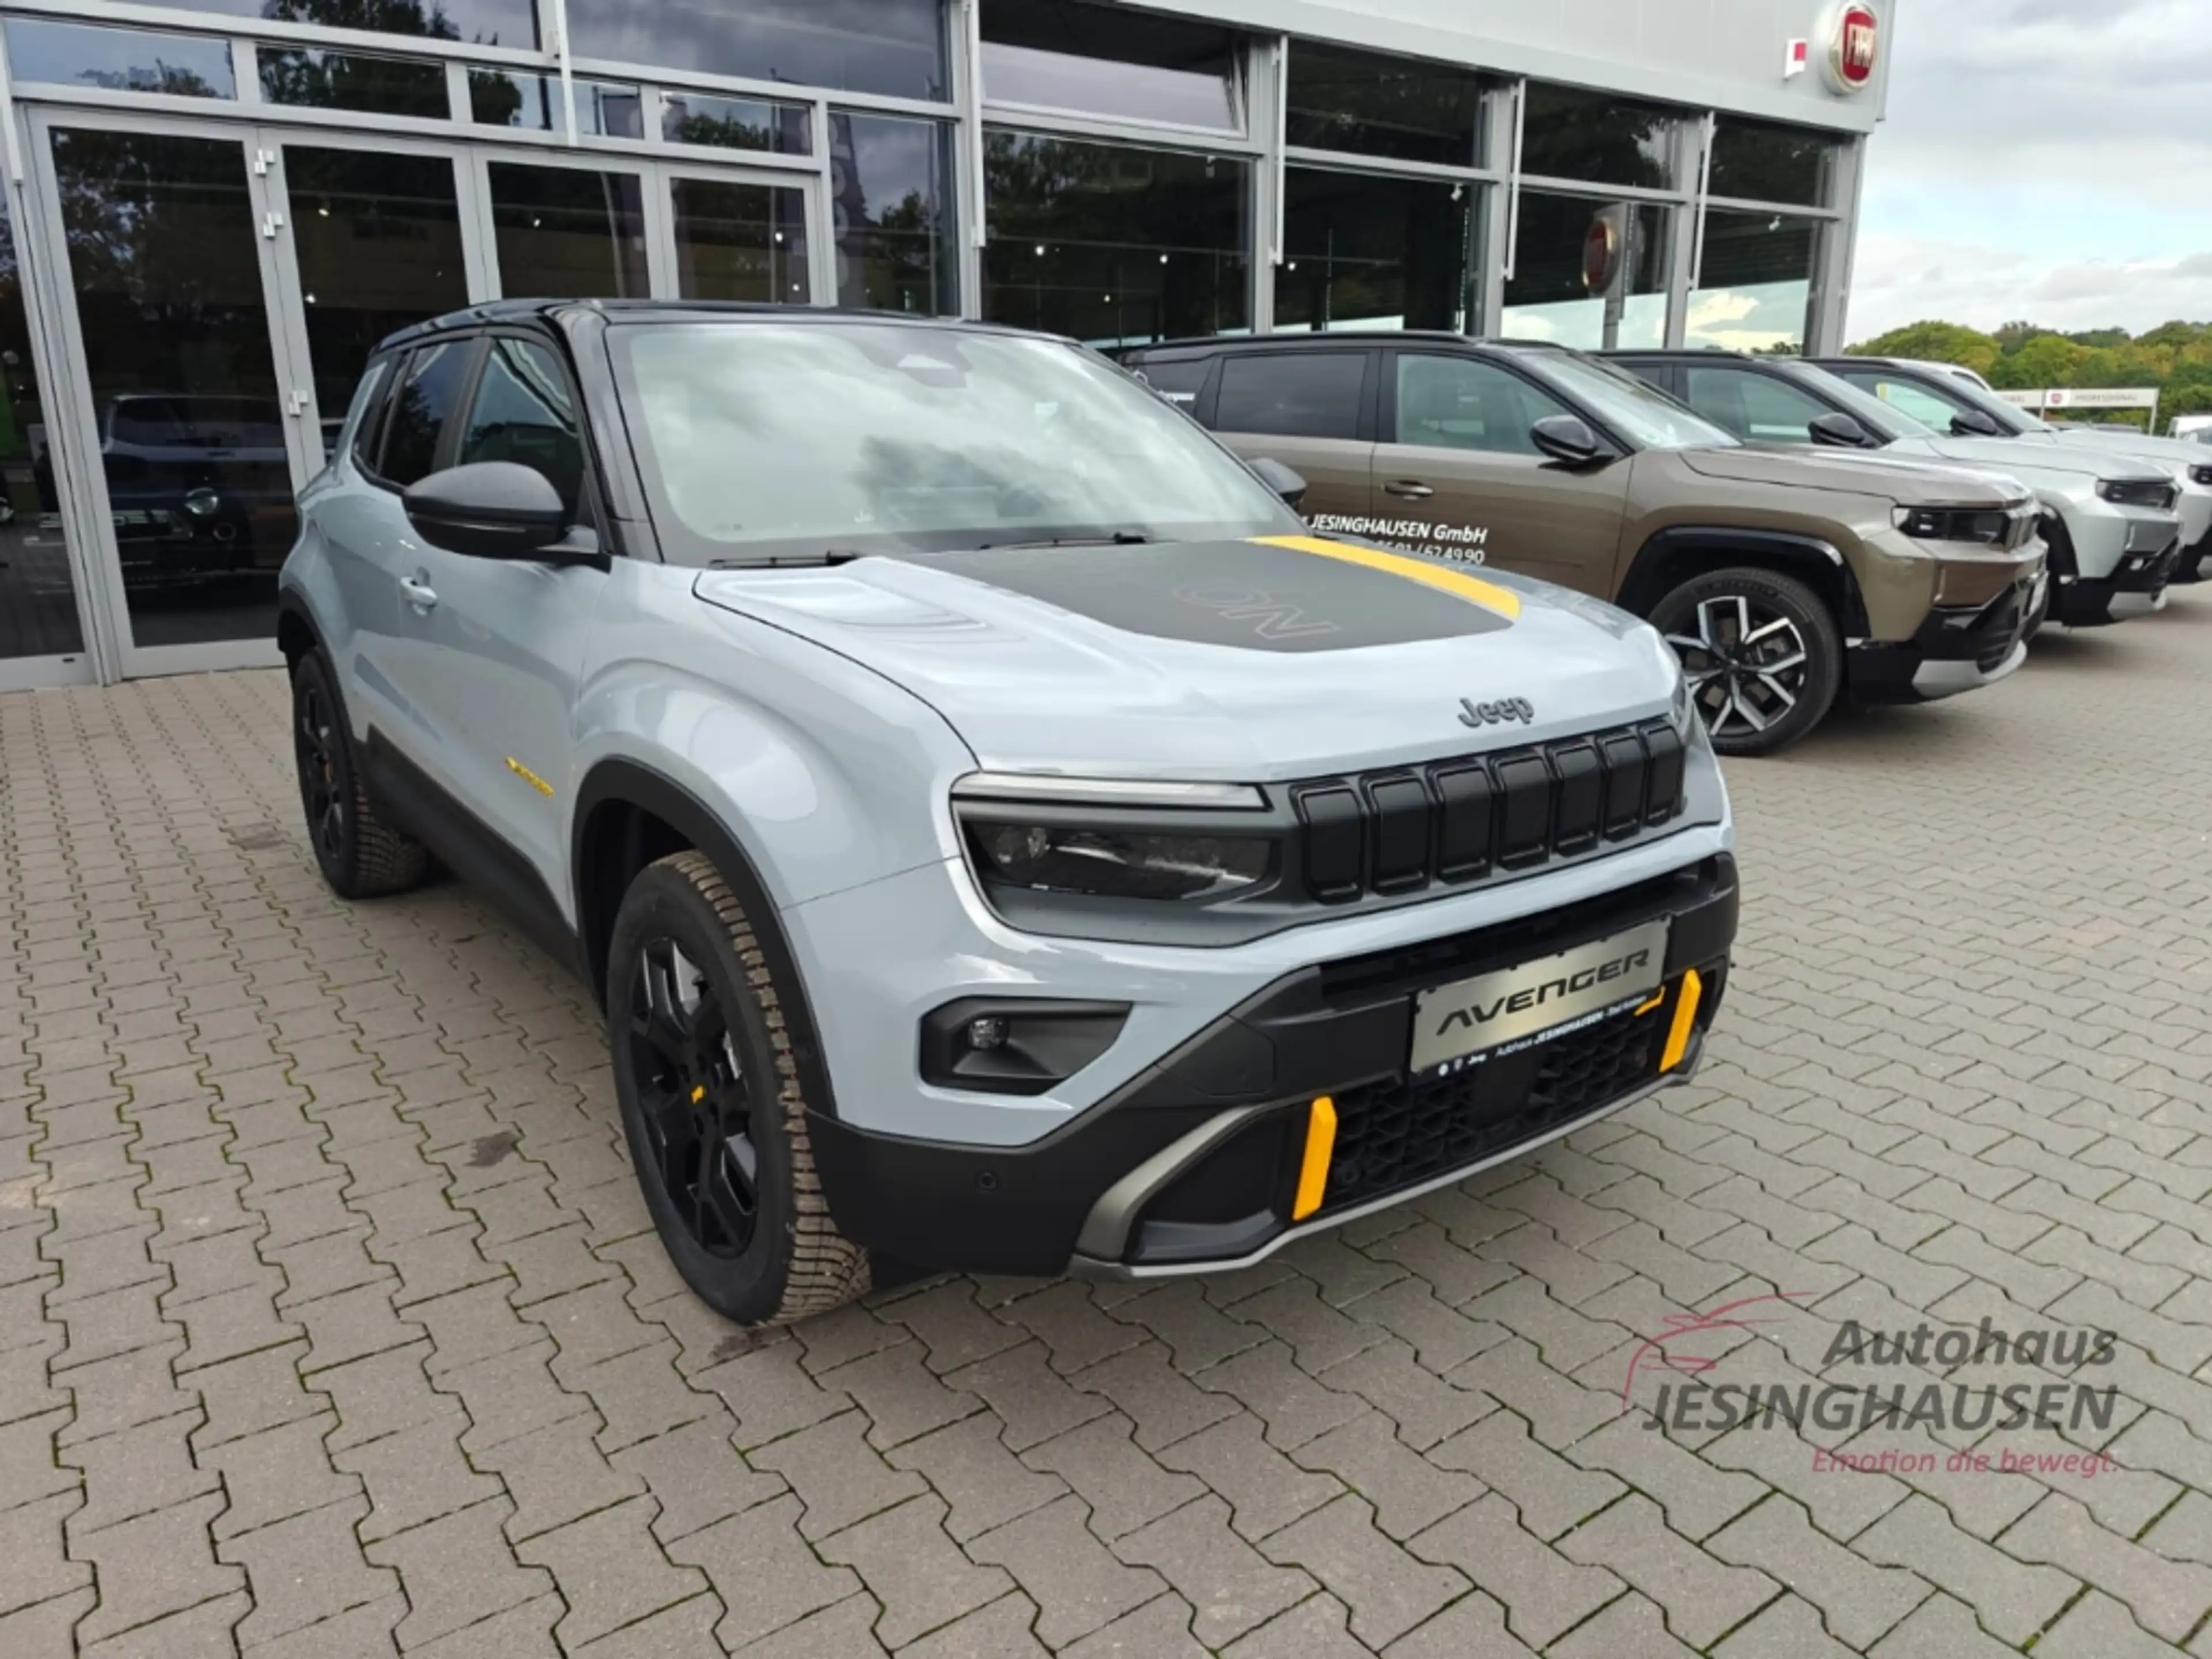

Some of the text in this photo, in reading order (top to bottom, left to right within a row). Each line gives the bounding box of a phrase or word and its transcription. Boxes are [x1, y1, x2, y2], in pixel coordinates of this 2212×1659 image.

[1311, 513, 1488, 544] JESINGHAUSEN GmbH
[1457, 696, 1535, 729] Jeep
[1436, 948, 1649, 1036] AVENGER
